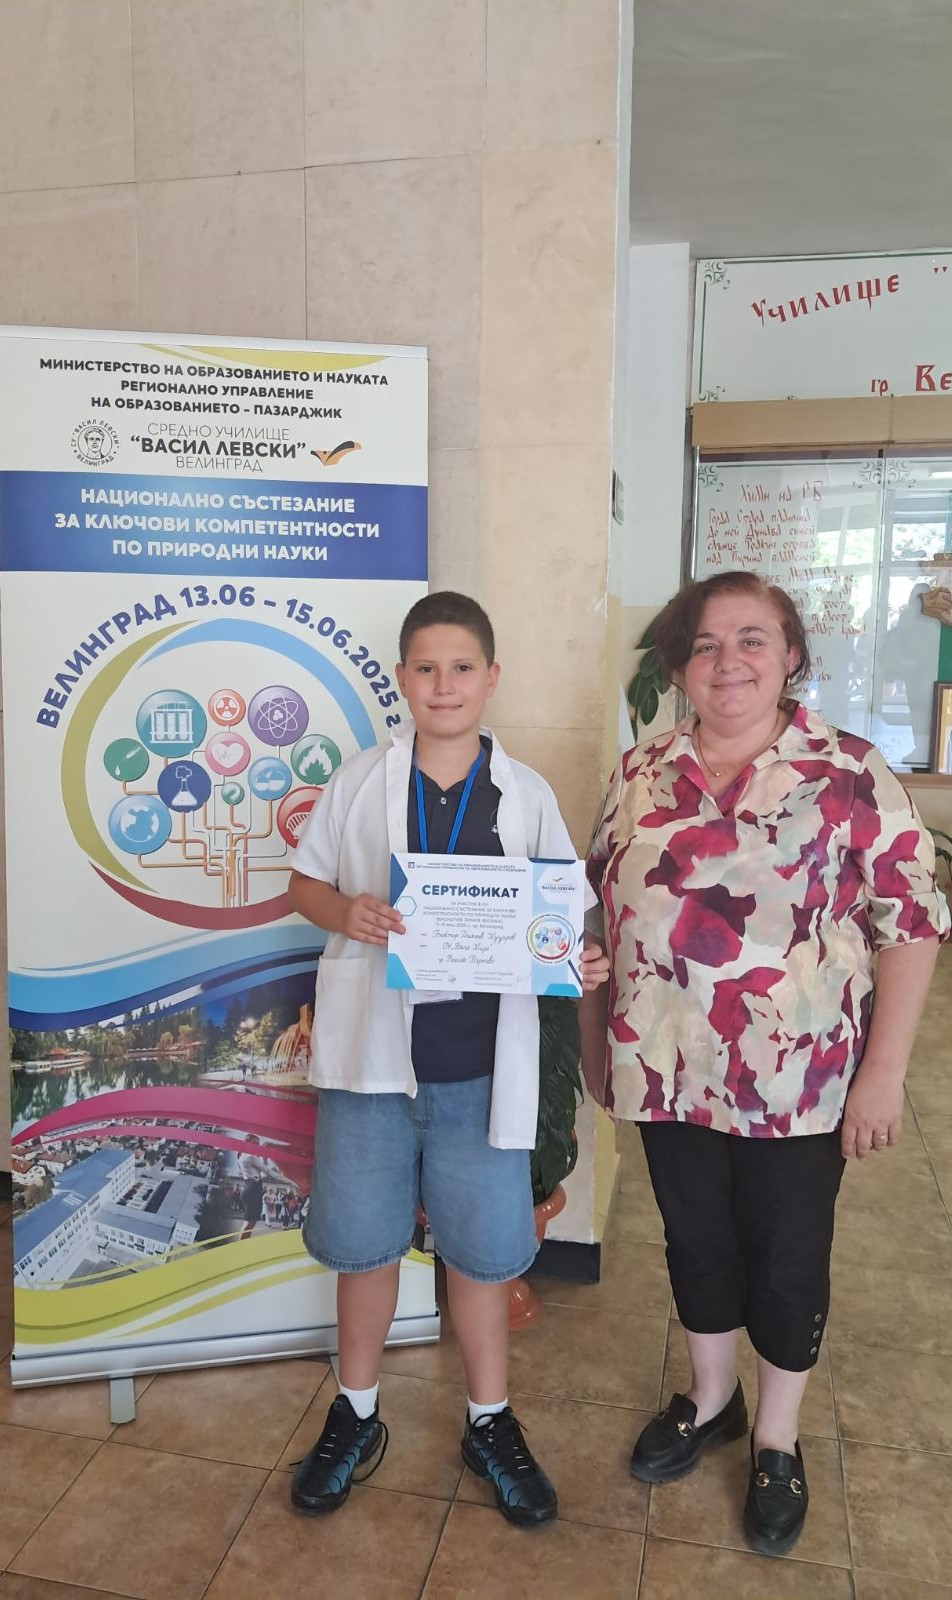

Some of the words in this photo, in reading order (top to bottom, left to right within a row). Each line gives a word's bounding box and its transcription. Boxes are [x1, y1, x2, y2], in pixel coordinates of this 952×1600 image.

[751, 274, 899, 326] Училище
[40, 359, 160, 375] МИНИСТЕРСТВО
[164, 365, 183, 376] НА
[187, 366, 309, 382] ОБРАЗОВАНИЕТО
[313, 372, 322, 382] И
[326, 372, 388, 386] НАУКАТА
[121, 381, 218, 395] РЕГИОНАЛНО
[222, 385, 313, 400] УПРАВЛЕНИЕ
[91, 397, 111, 408] НА
[115, 398, 240, 414] ОБРАЗОВАНИЕТО
[254, 404, 342, 420] ПАЗАРДЖИК
[148, 423, 211, 438] СРЕДНО
[216, 425, 289, 442] УЧИЛИЩЕ
[131, 436, 210, 454] “ВАСИЛ
[216, 439, 306, 458] ЛЕВСКИ”
[176, 456, 263, 473] ВЕЛИНГРАД
[81, 488, 224, 508] НАЦИОНАЛНО
[229, 494, 354, 512] СЪСТЕЗАНИЕ
[55, 513, 80, 528] ЗА
[85, 515, 189, 532] КЛЮЧОВИ
[195, 519, 379, 538] КОМПЕТЕНТНОСТИ
[113, 539, 142, 555] ПО
[147, 540, 259, 561] ПРИРОДНИ
[264, 545, 327, 561] НАУКИ
[36, 593, 177, 729] ВЕЛИНГРАД
[179, 584, 255, 609] 13.06
[285, 598, 400, 709] 15.06.2025
[422, 885, 519, 898] СЕРТИФИКАТ
